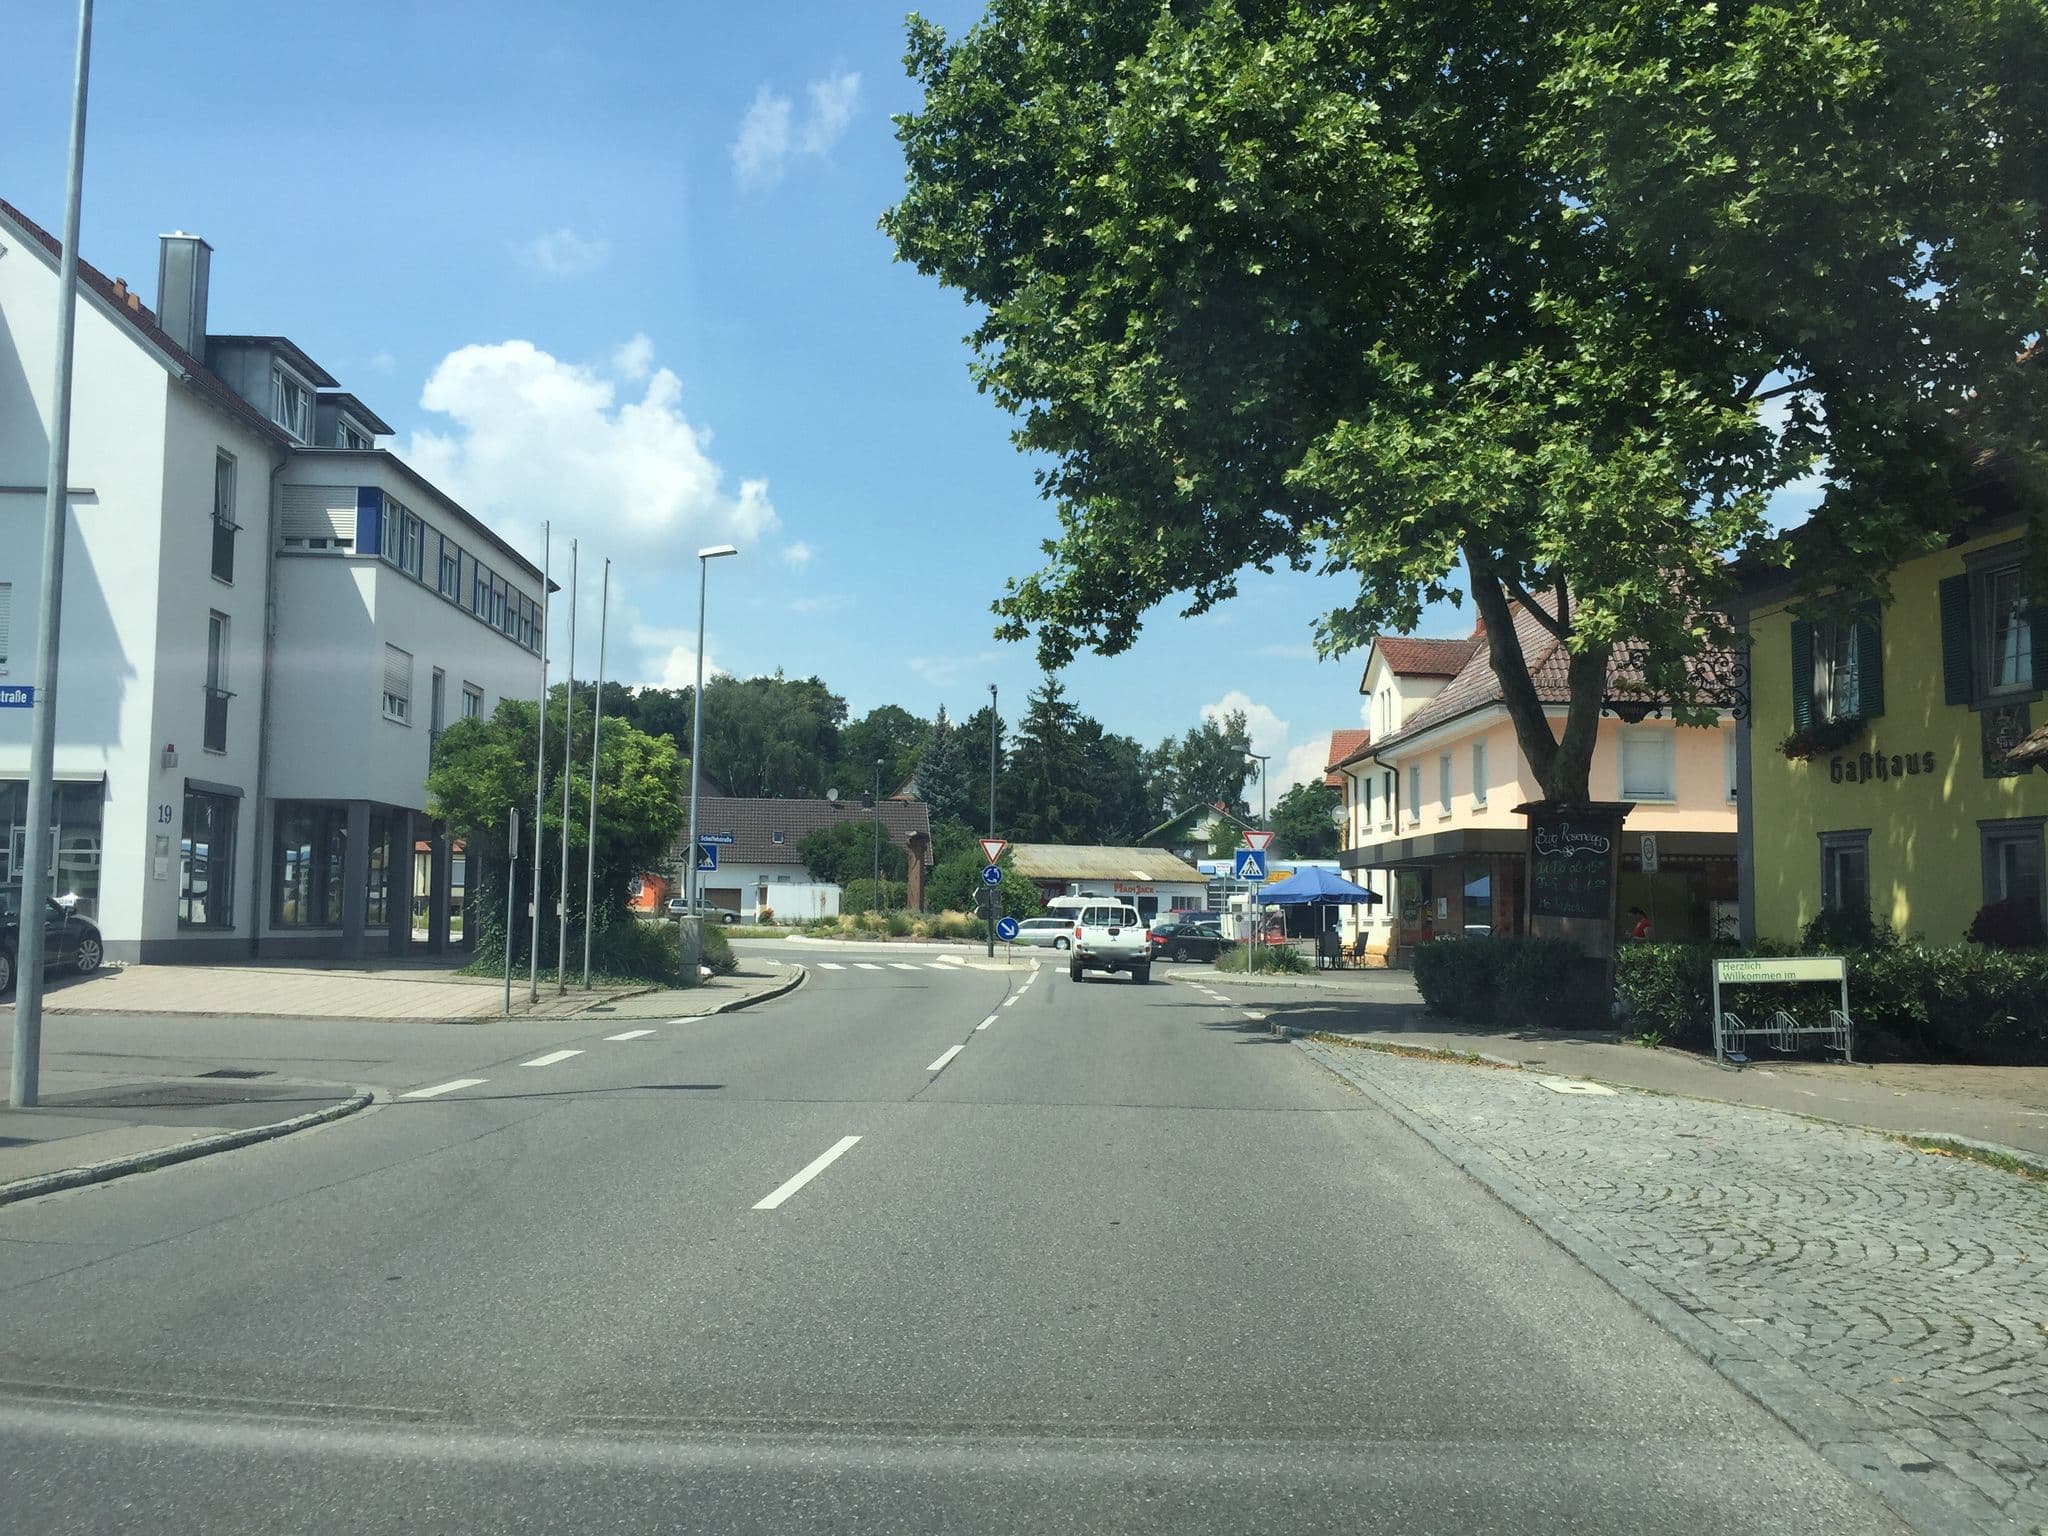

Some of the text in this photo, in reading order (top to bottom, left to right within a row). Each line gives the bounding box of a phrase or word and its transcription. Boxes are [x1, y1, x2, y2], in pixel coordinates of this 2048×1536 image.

[1830, 750, 1936, 784] Gasthaus
[158, 804, 172, 824] 19
[1723, 961, 1761, 970] Herzlich
[1723, 971, 1796, 980] Willkommen im
